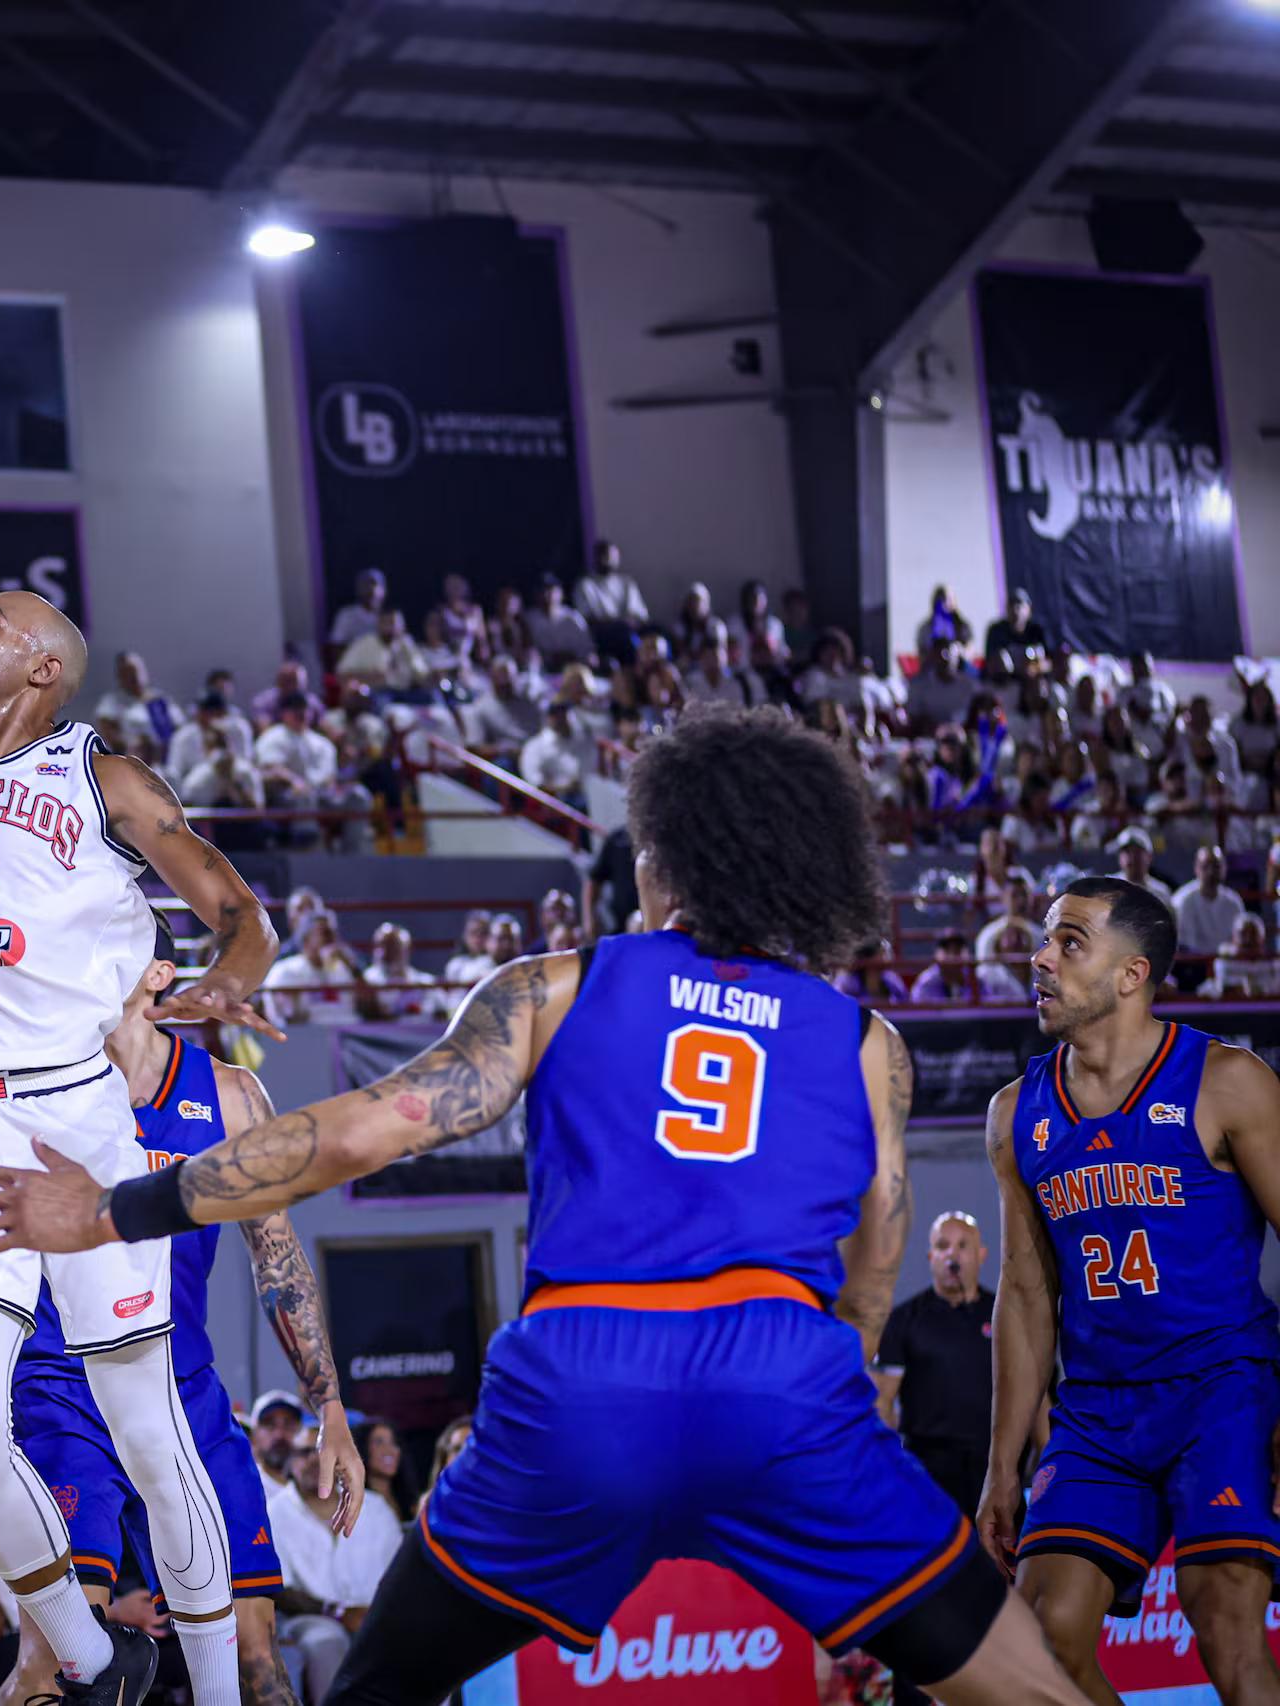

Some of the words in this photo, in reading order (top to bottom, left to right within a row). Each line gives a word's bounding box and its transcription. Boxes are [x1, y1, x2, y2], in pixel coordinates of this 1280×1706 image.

[342, 393, 397, 464] LB
[670, 974, 782, 1030] WILSON
[654, 1022, 767, 1164] 9
[1033, 1118, 1051, 1152] 4
[1036, 1162, 1186, 1221] SANTURCE
[1080, 1229, 1160, 1301] 24
